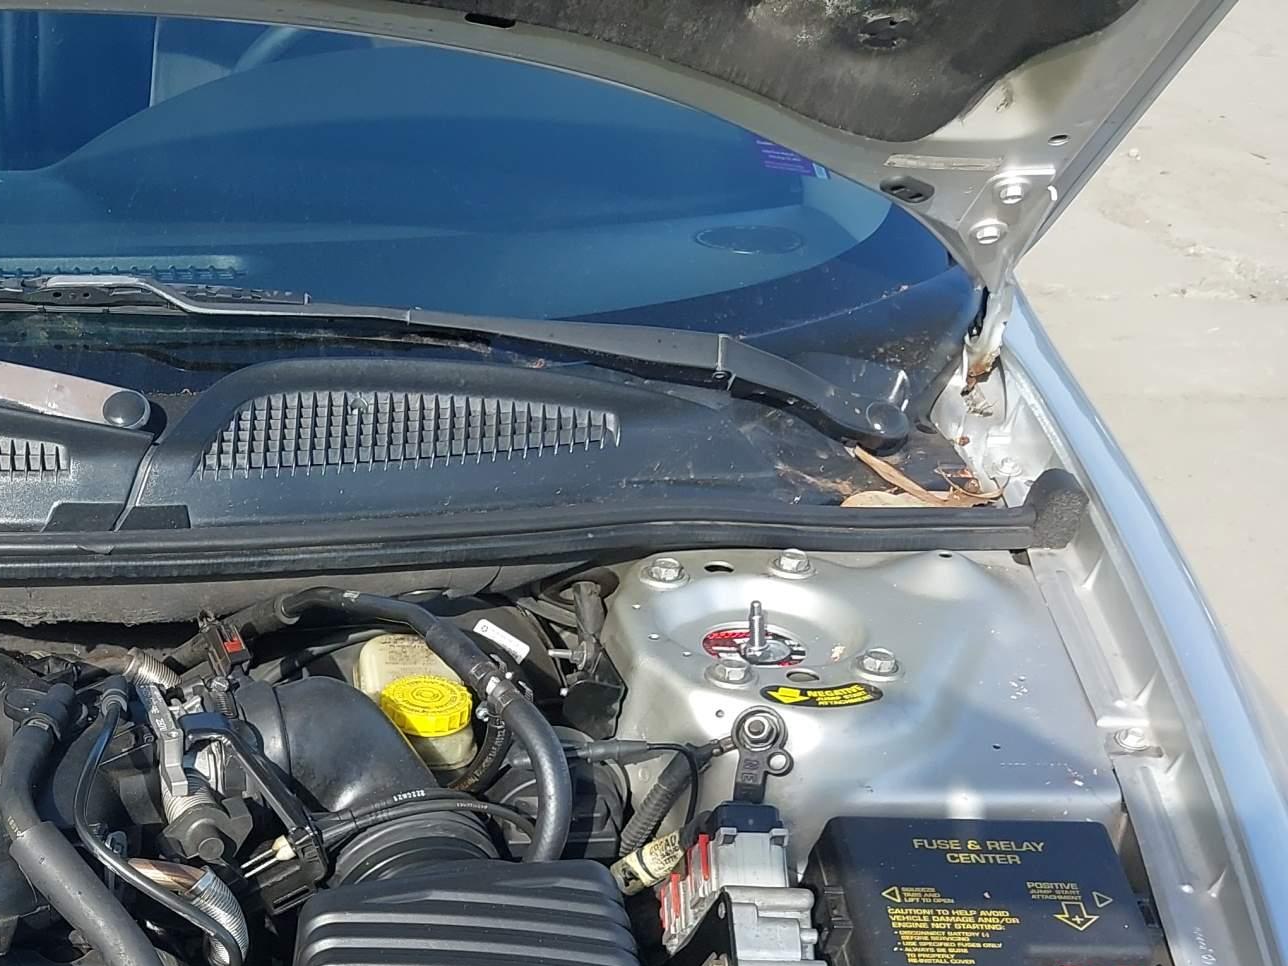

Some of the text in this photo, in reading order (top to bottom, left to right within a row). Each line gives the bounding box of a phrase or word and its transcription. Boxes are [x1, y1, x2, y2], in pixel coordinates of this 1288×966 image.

[807, 684, 865, 697] NEGATIVE
[913, 839, 1045, 852] FUSE & RELAY
[946, 853, 1022, 865] CENTER
[1027, 882, 1079, 890] POSITIVE
[888, 908, 934, 916] CAUTION!
[978, 917, 1021, 925] AND/OR
[955, 923, 1006, 931] STARTING:
